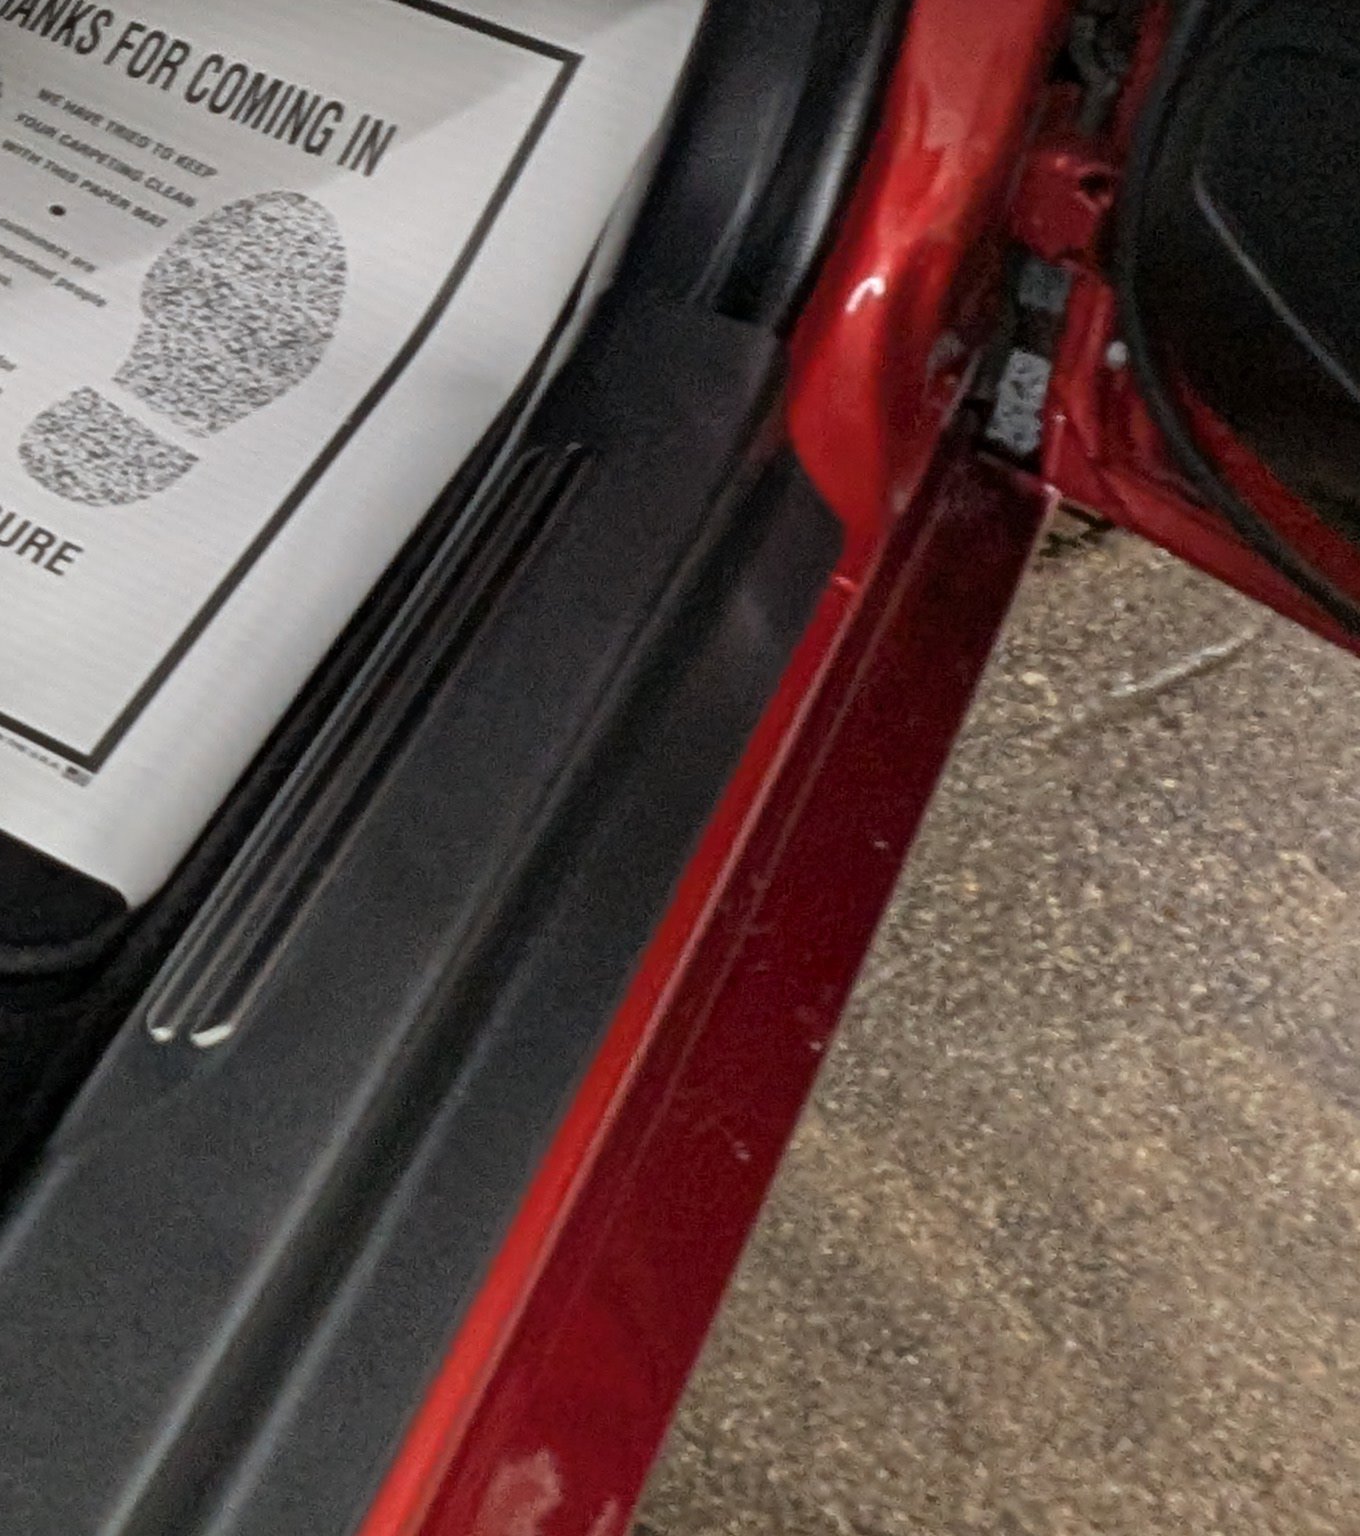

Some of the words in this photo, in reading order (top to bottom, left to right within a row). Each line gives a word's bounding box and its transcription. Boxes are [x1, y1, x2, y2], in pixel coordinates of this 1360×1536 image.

[38, 88, 64, 106] WE
[63, 100, 104, 127] HAVE
[105, 120, 153, 148] TRIED
[152, 143, 176, 160] TO
[174, 155, 218, 178] KEEP
[104, 22, 190, 91] FOR
[185, 54, 344, 156] COMING
[336, 113, 397, 178] IN
[2, 139, 42, 164] WITH
[43, 160, 79, 183] THIS
[80, 179, 131, 209] PAPER
[132, 206, 168, 228] MAT
[15, 113, 57, 138] YOUR
[58, 134, 144, 182] CARPETING
[144, 176, 196, 207] CLEAN
